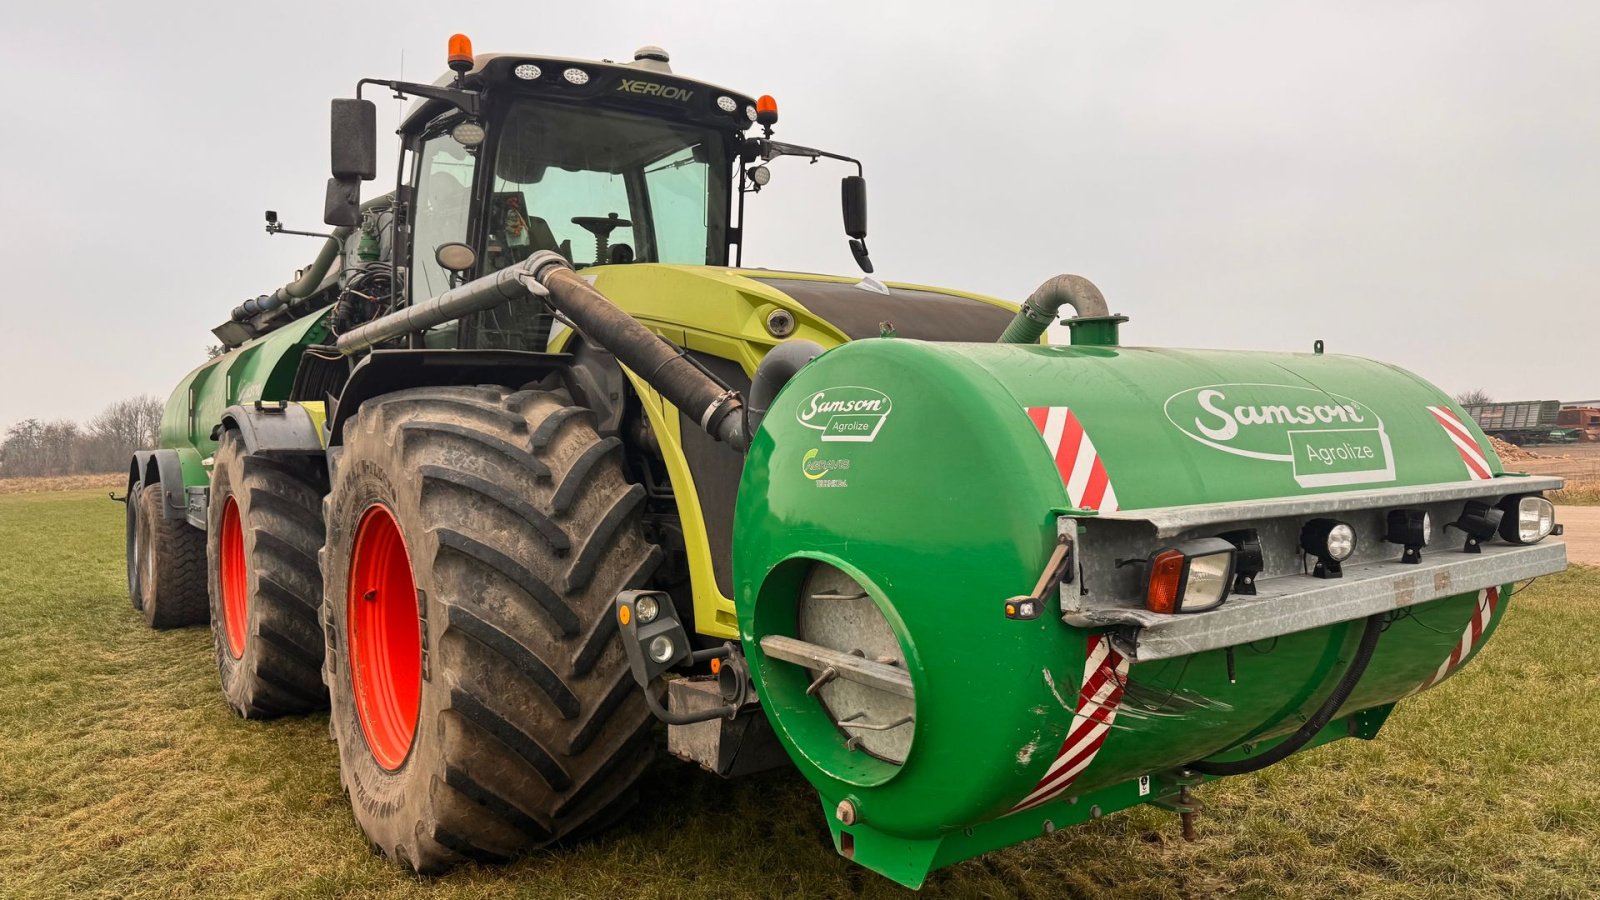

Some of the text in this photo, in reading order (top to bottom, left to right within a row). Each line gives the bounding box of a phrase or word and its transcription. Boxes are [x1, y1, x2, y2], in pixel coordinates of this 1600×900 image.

[616, 79, 694, 102] XERION
[832, 421, 869, 432] Agrolize
[1306, 443, 1374, 465] Agrolize
